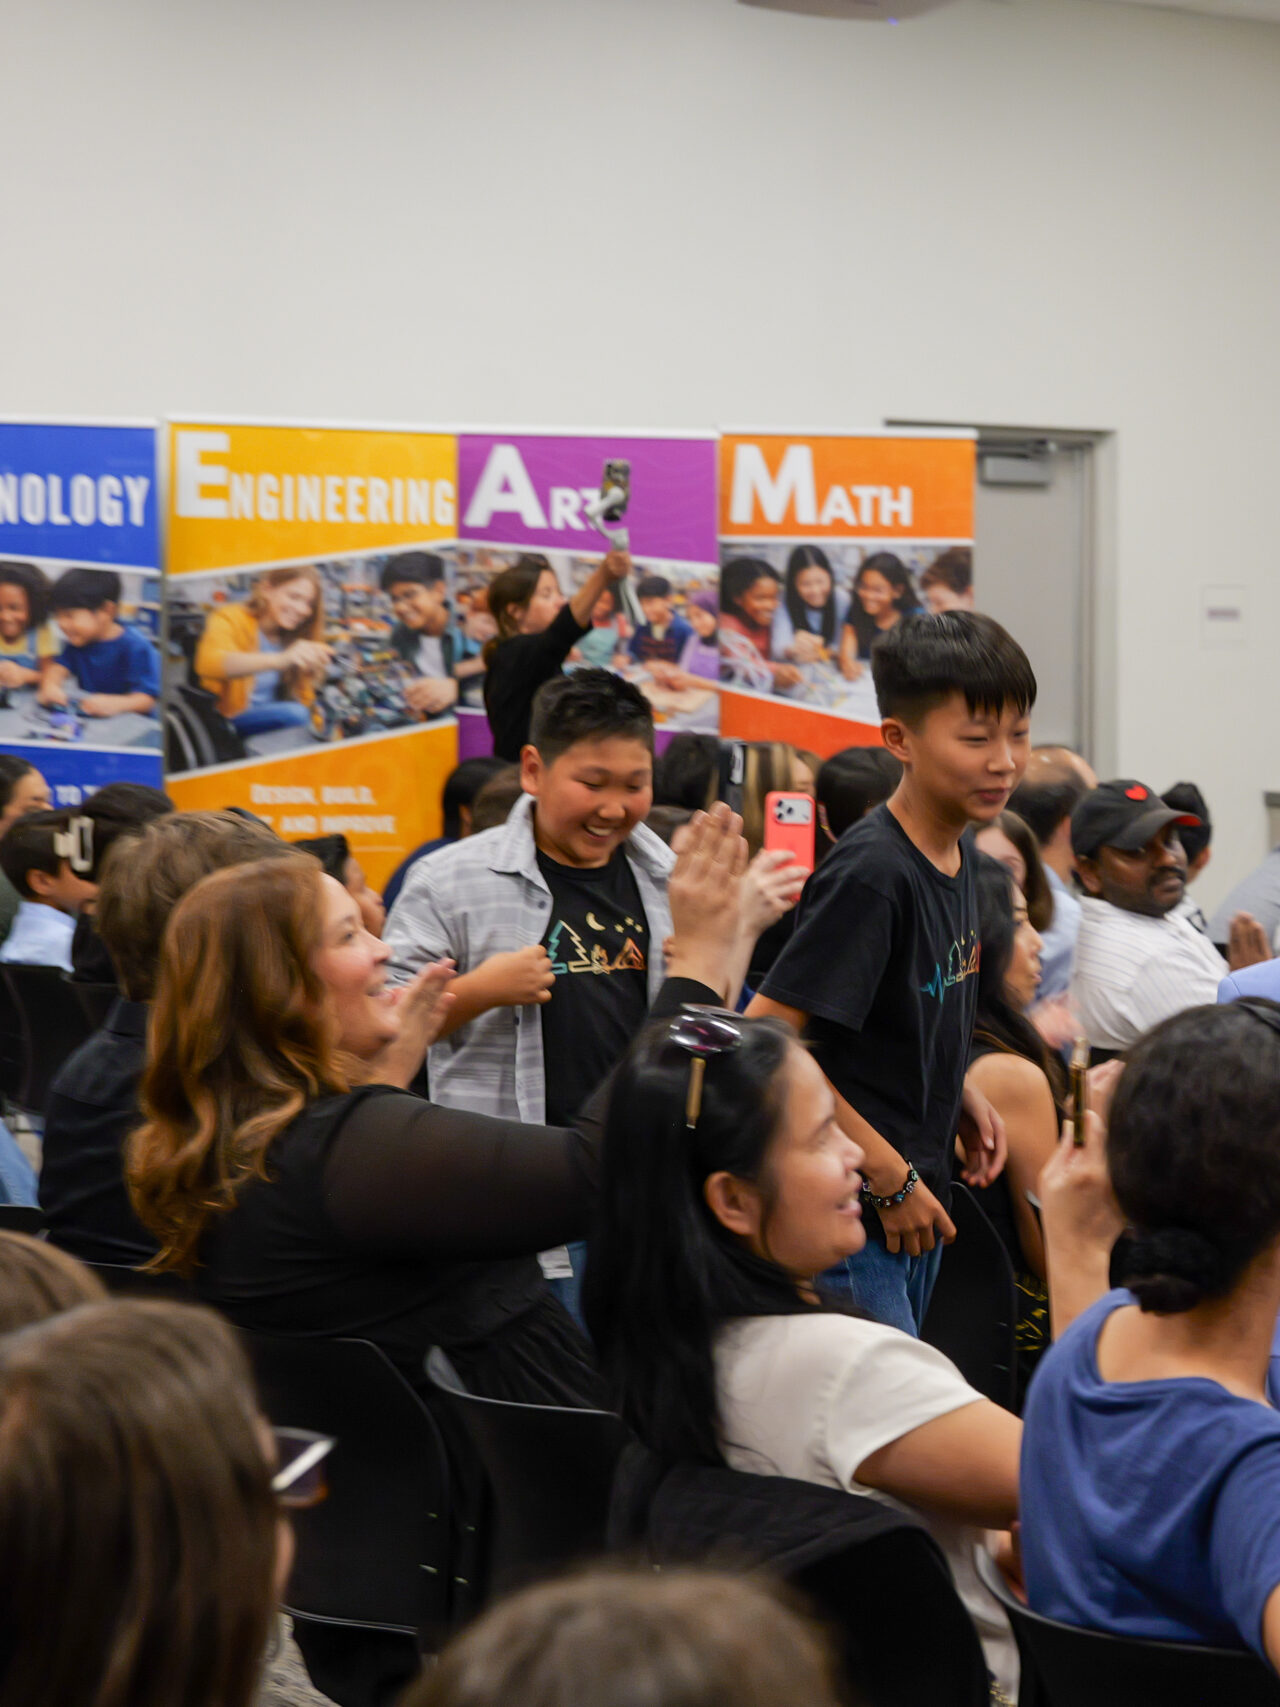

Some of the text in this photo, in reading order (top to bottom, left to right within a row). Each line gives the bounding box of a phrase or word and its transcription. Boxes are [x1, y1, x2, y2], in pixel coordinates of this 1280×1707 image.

[0, 472, 150, 527] NOLOGY
[175, 430, 456, 527] ENGINEERING
[729, 443, 913, 527] MATH
